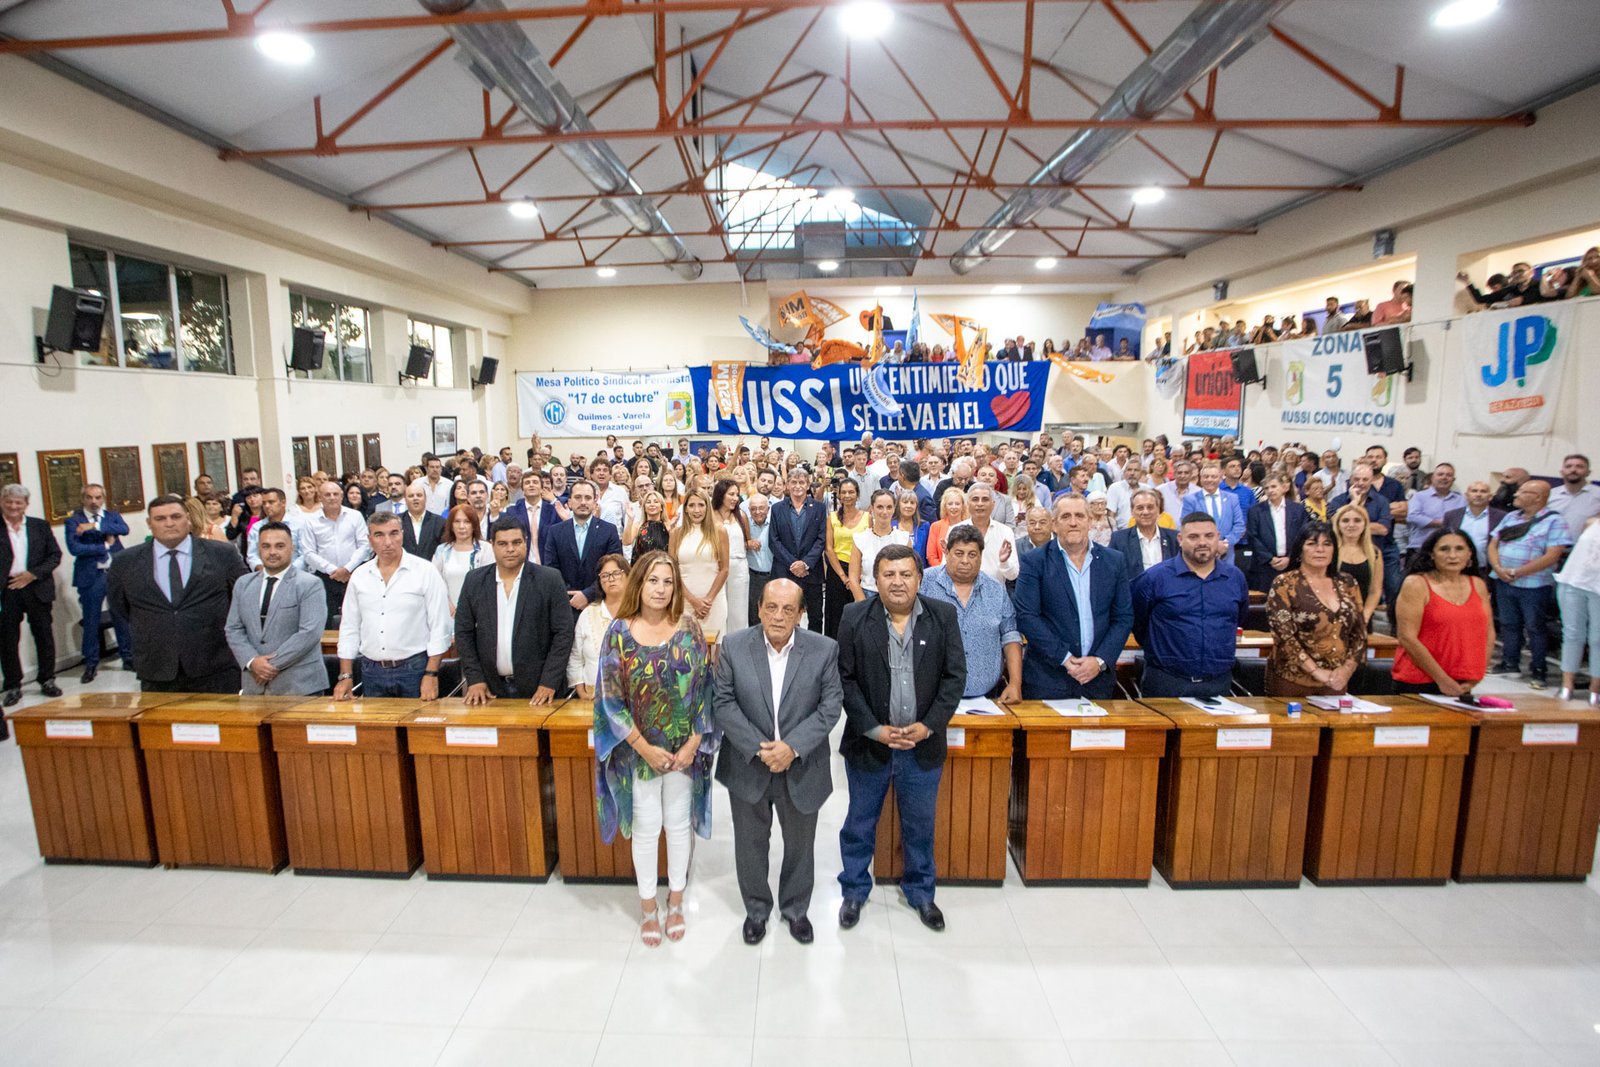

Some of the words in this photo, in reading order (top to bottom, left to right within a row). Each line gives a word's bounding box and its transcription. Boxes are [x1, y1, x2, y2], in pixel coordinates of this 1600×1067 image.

[1312, 332, 1362, 356] ZONA
[1481, 315, 1556, 387] JP
[536, 377, 560, 387] Mesa
[602, 375, 642, 386] Sindical
[994, 362, 1030, 395] QUE
[1326, 364, 1343, 398] 5
[568, 393, 587, 404] "17
[591, 393, 605, 404] de
[609, 391, 659, 404] octubre"
[577, 413, 613, 421] Quilmes
[623, 412, 651, 421] Varela
[591, 422, 643, 432] Berazategui
[851, 403, 875, 432] SE
[939, 402, 960, 431] EN
[963, 402, 984, 430] EL
